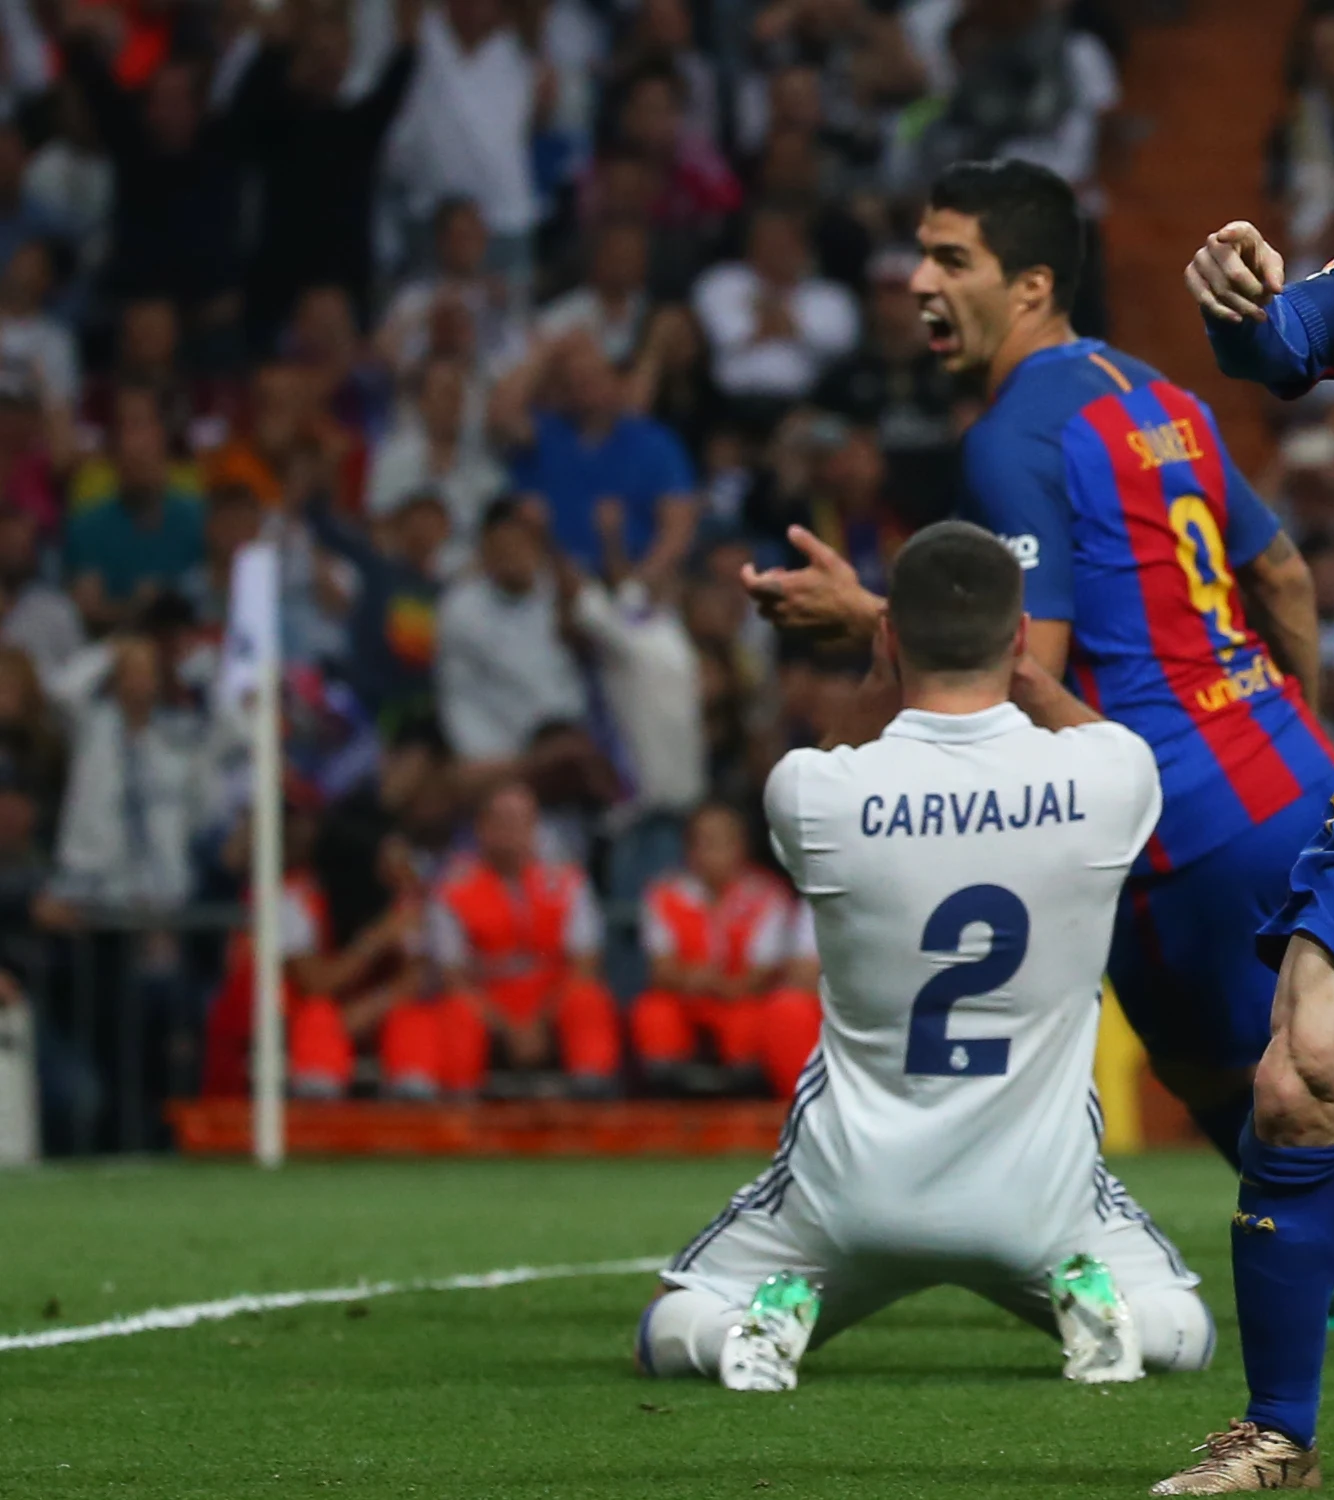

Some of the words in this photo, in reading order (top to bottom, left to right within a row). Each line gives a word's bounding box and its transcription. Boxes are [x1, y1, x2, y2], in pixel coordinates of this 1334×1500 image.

[1168, 494, 1246, 661] 9
[860, 779, 1085, 838] CARVAJAL
[904, 883, 1030, 1077] 2
